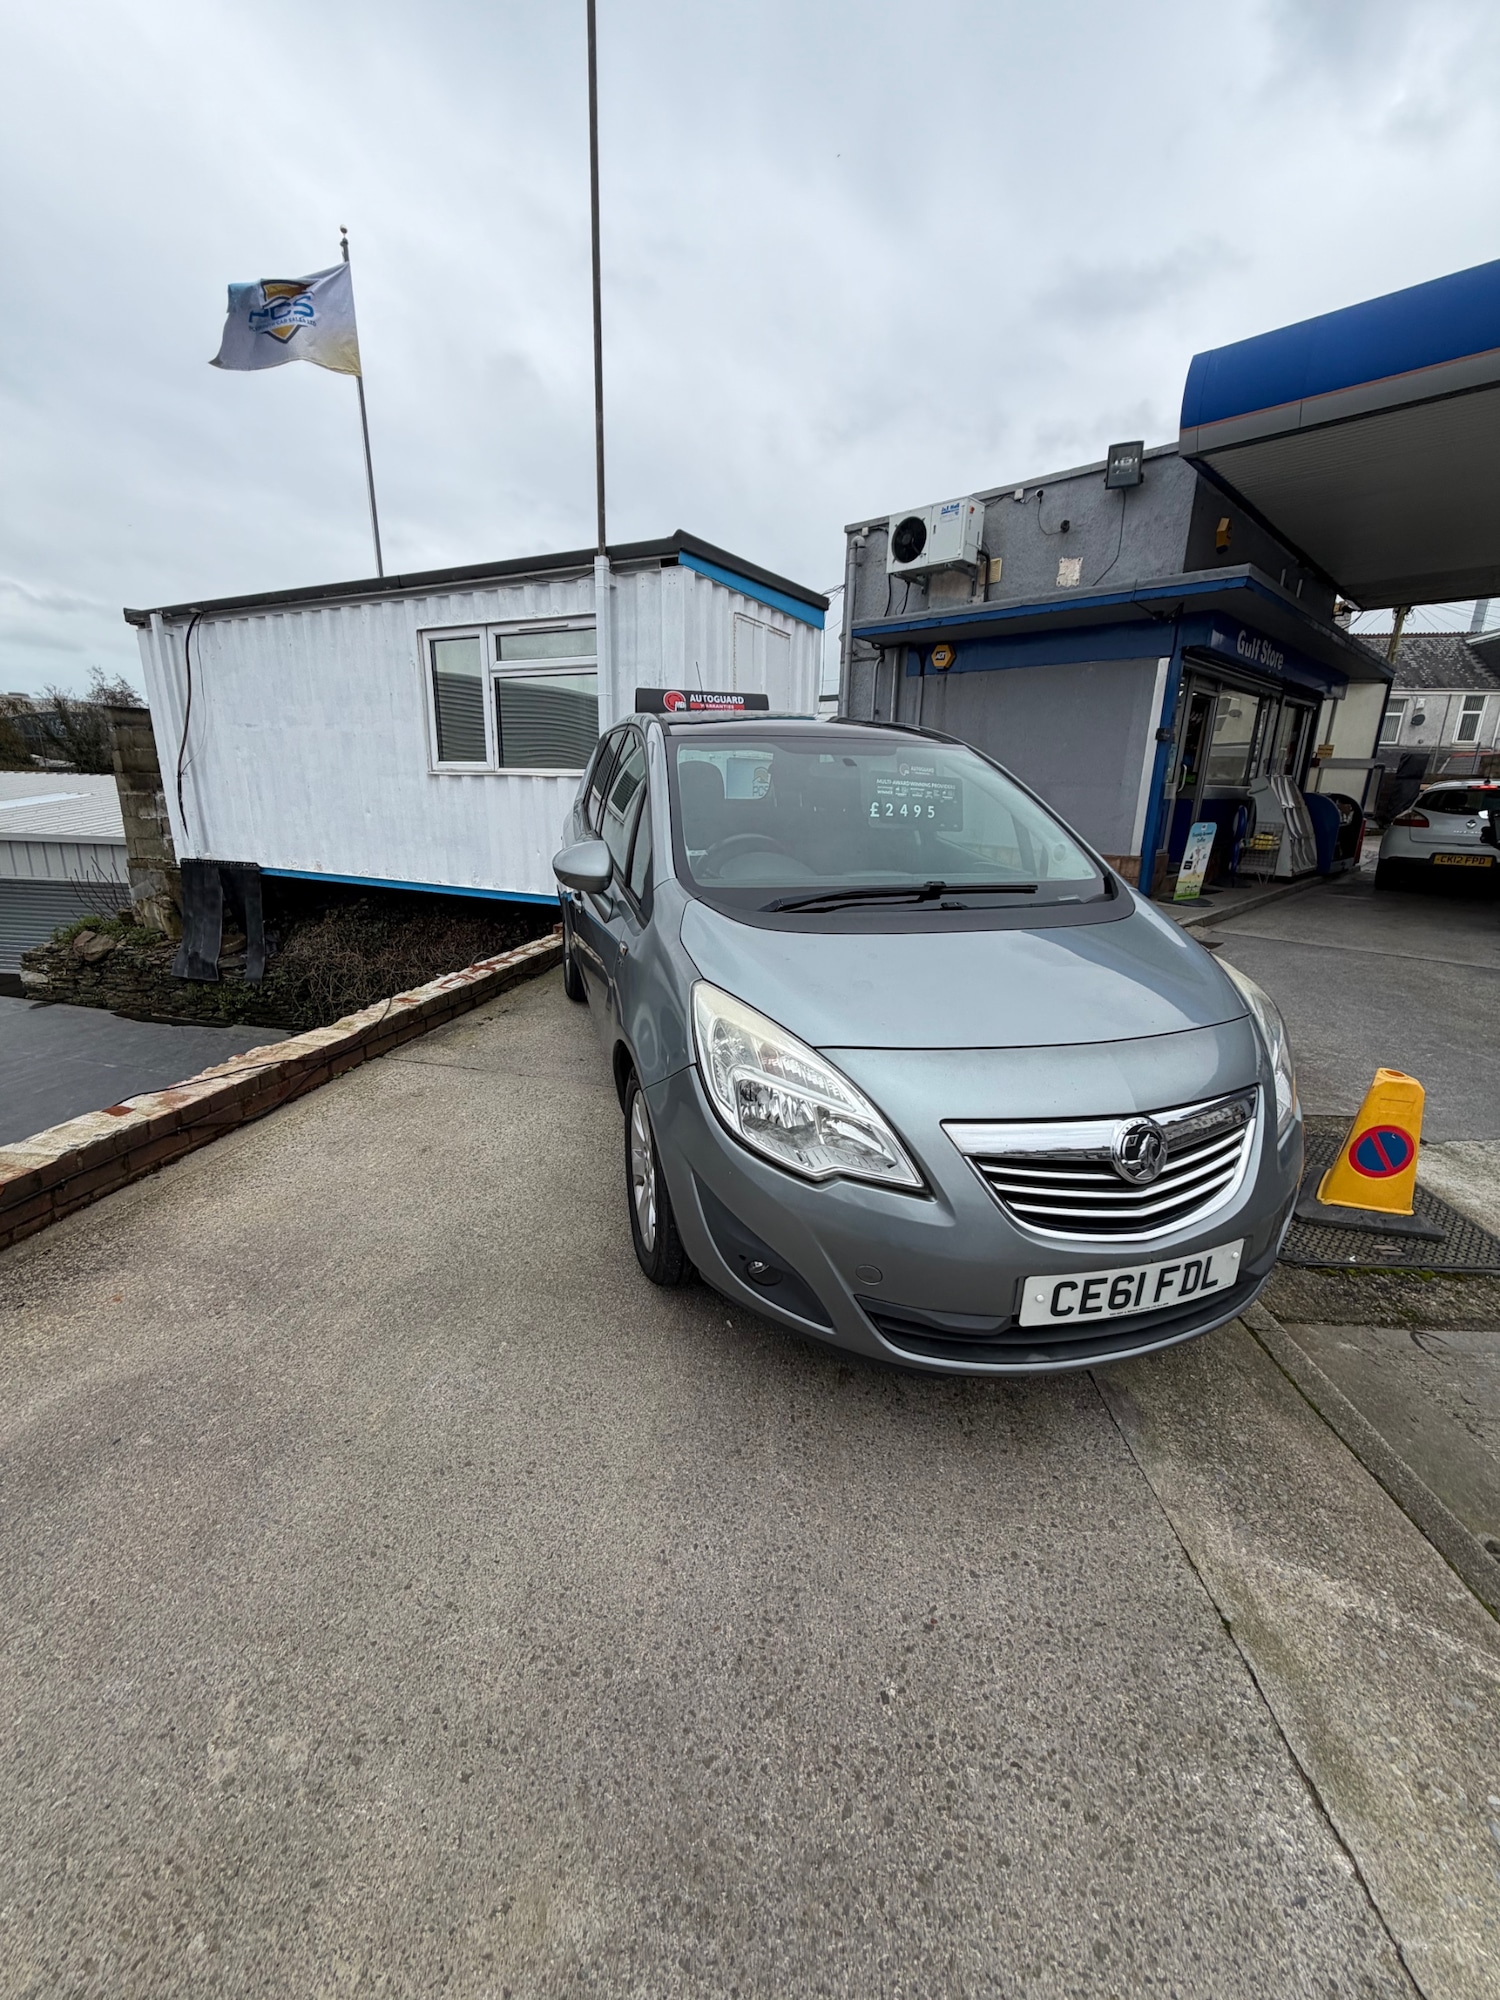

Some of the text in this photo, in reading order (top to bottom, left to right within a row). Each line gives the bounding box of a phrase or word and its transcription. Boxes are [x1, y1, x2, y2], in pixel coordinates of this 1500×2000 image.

[1237, 630, 1284, 670] Gulf Store
[689, 694, 744, 704] AUTOGUARD
[1440, 855, 1486, 865] CK12 FPD
[1121, 1120, 1157, 1135] VAUXHA
[1050, 1256, 1218, 1318] CE61 FDL
